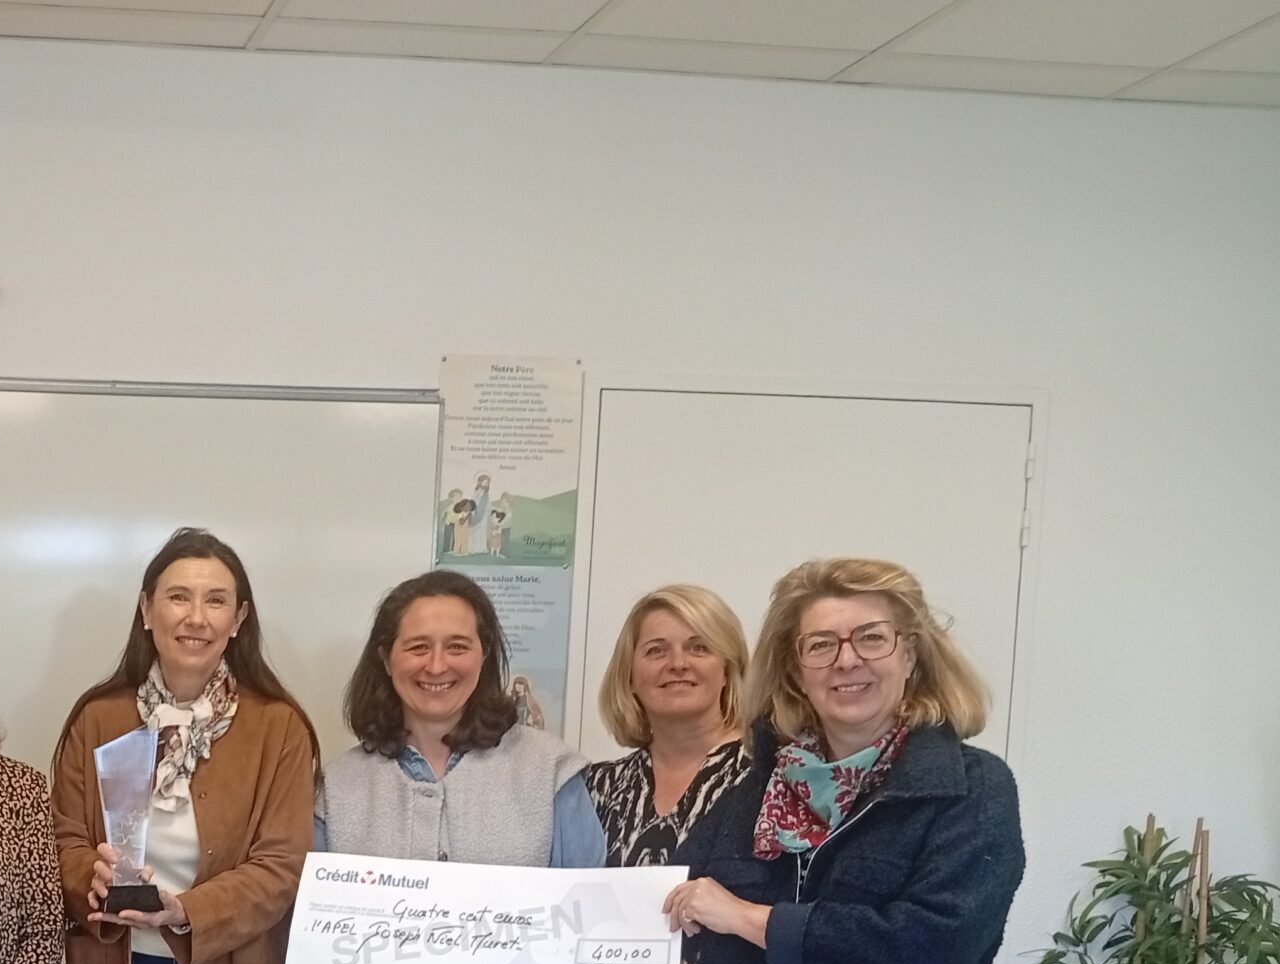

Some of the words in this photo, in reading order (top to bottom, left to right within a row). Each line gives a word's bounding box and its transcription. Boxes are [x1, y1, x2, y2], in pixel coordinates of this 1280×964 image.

[315, 867, 359, 884] Crédit
[377, 873, 430, 890] Mutuel
[591, 944, 652, 961] 400,00
